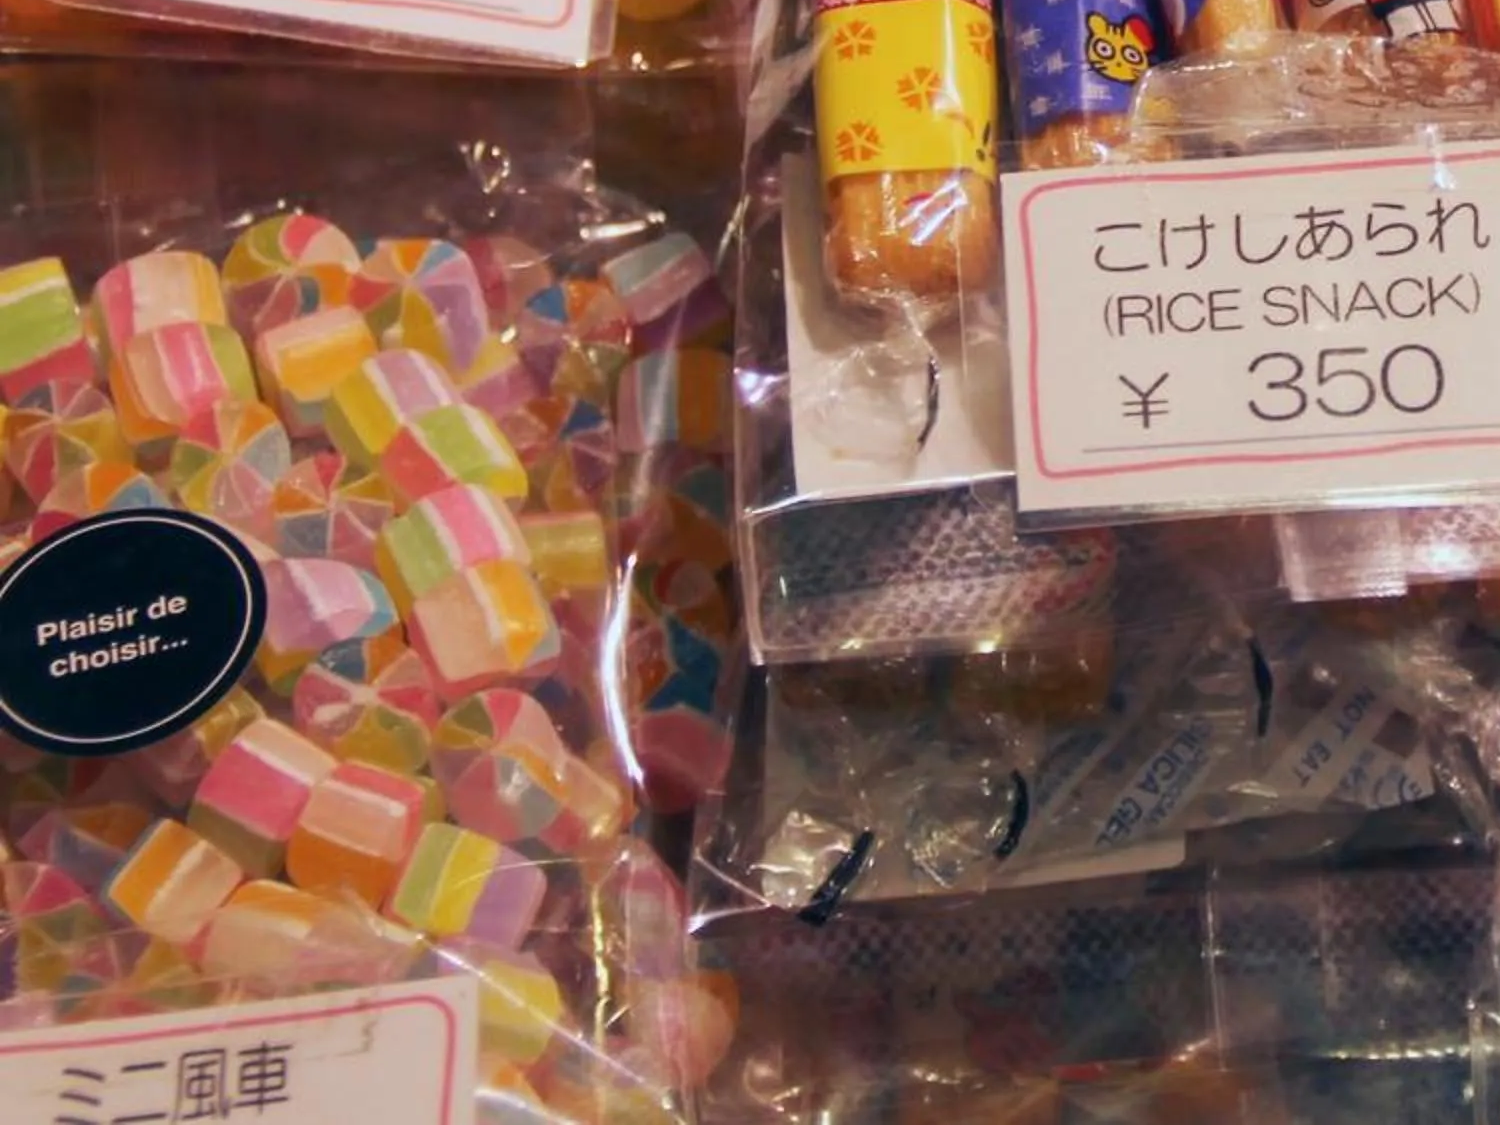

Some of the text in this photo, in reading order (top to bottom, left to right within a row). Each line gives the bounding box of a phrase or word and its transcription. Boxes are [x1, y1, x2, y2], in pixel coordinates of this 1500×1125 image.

[1093, 197, 1492, 274] こけしあられ
[1103, 271, 1482, 339] (RICE SNACK)
[1117, 343, 1446, 430] ¥ 350
[36, 595, 188, 647] Plaisir de
[49, 634, 189, 678] choisir...
[1096, 796, 1143, 849] GEL
[54, 1040, 294, 1125] ミニ風車
